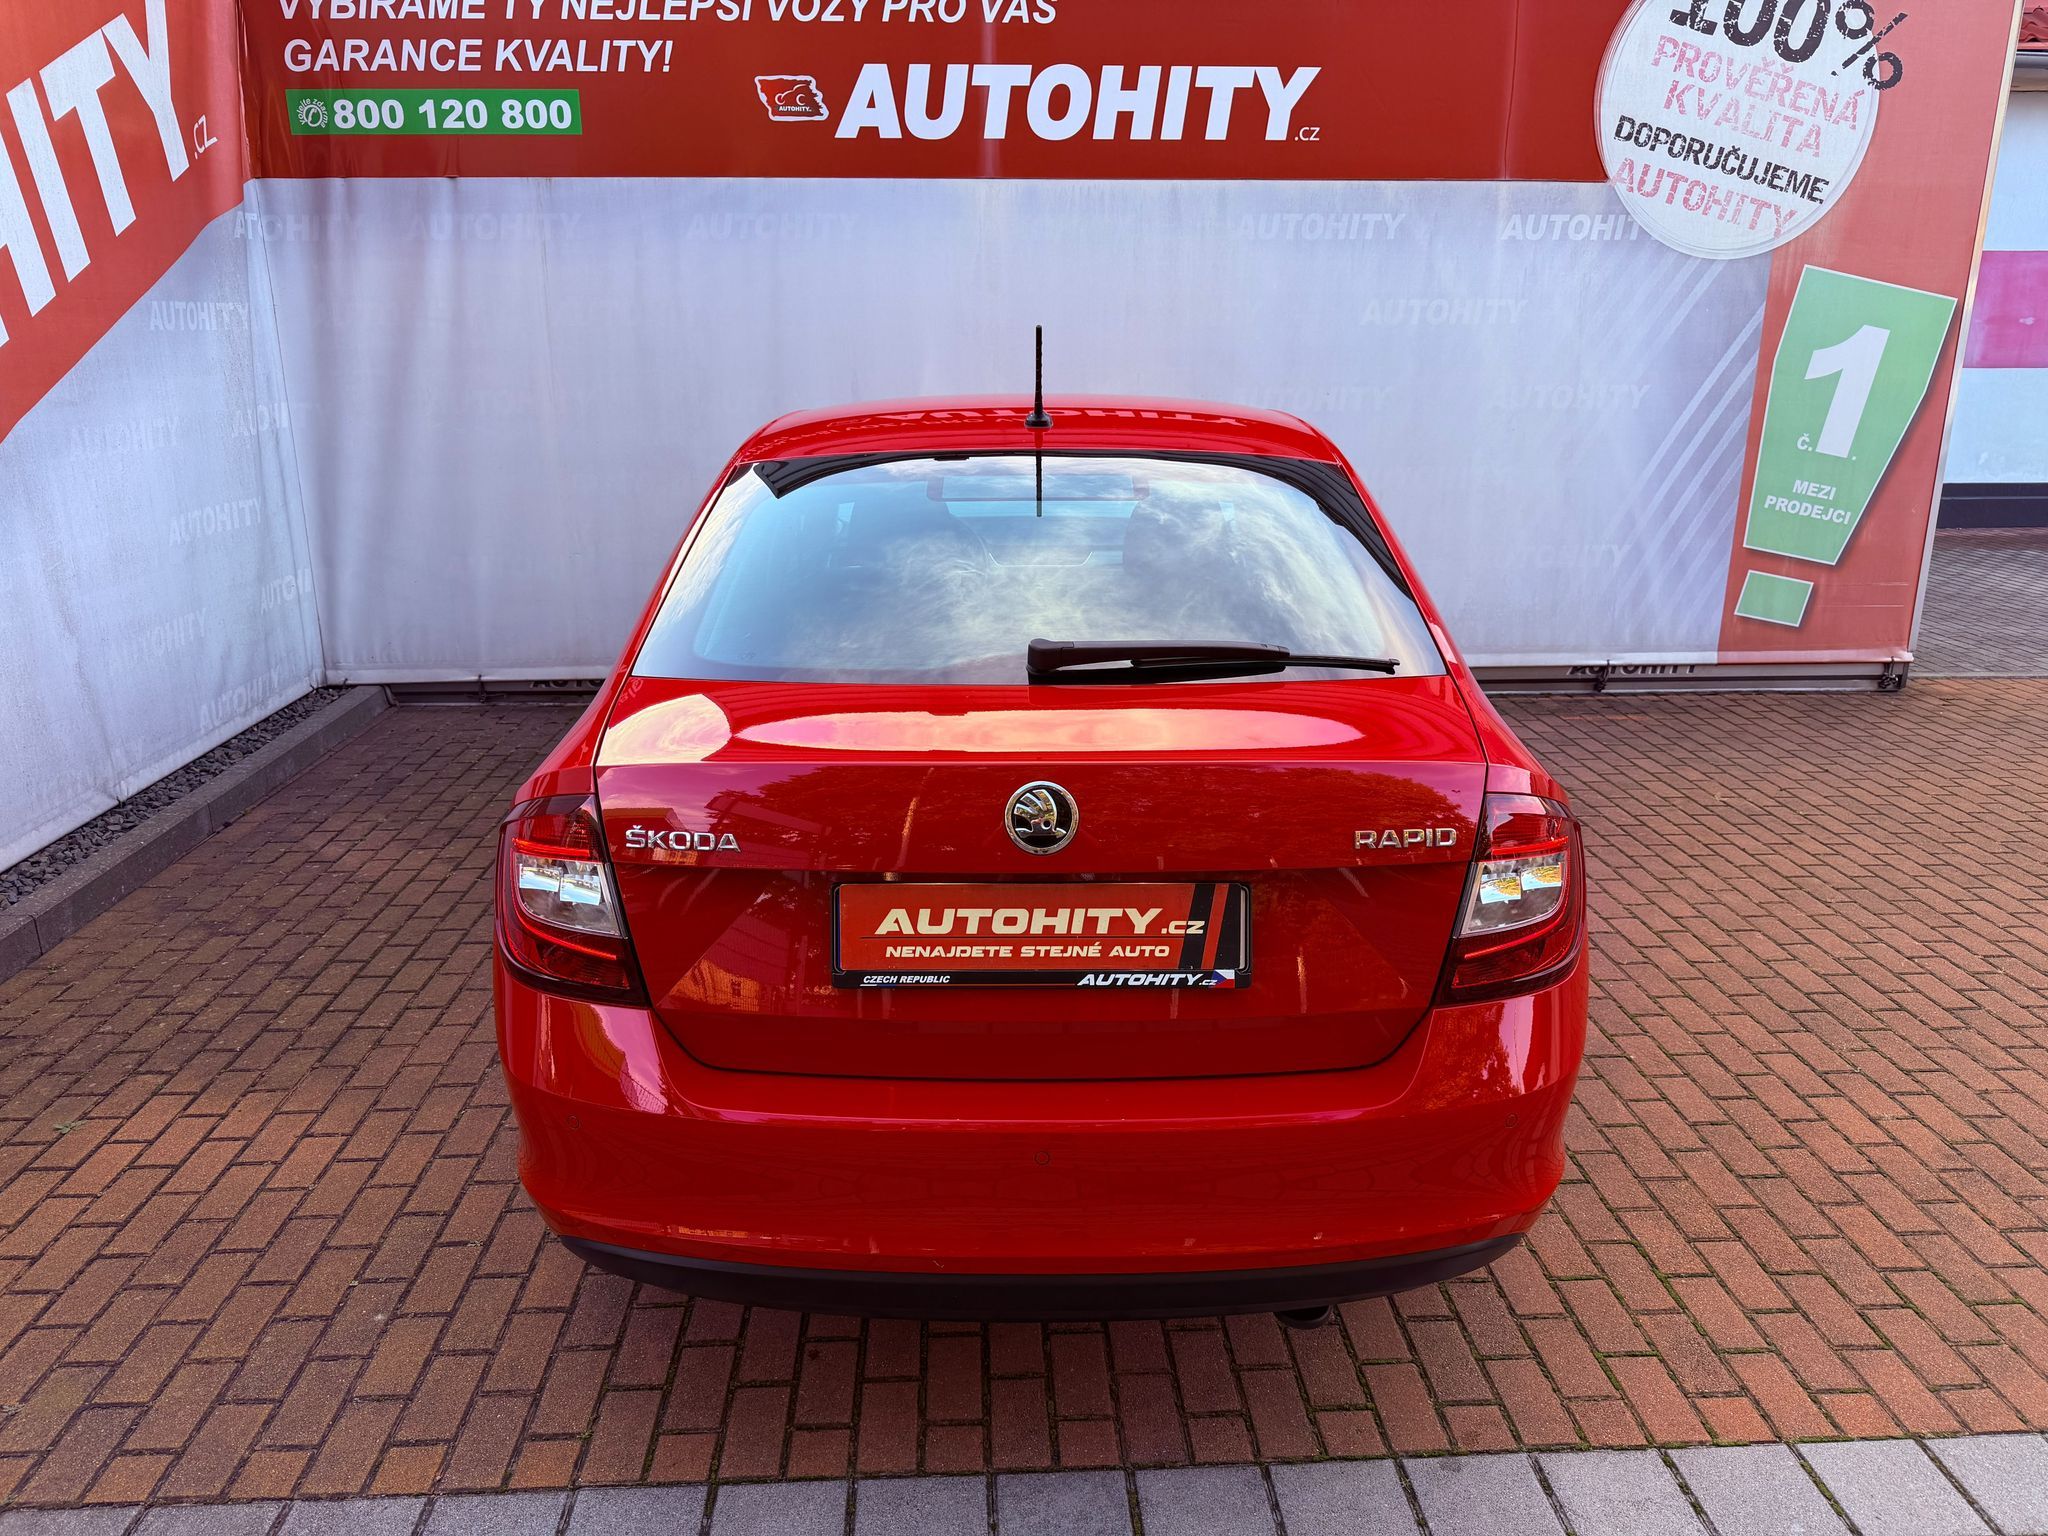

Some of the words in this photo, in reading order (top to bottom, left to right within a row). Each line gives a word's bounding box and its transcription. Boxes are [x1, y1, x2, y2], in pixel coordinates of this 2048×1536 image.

[882, 0, 964, 22] PRO
[284, 39, 483, 72] GARANCE
[494, 40, 673, 73] KVALITY!
[1650, 35, 1865, 131] PROVĚŘENÁ
[333, 98, 404, 130] 800
[418, 98, 488, 129] 120
[501, 98, 572, 130] 800
[1663, 80, 1822, 158] KVALITA
[1613, 114, 1830, 205] DOPORUČUJEME
[1607, 157, 1799, 239] AUTOHITY
[1235, 213, 1407, 241] AUTOHITY
[1500, 213, 1660, 242] AUTOHIT
[150, 301, 249, 331] AUTOHITY
[1359, 298, 1528, 326] AUTOHITY
[1792, 479, 1836, 501] MEZI
[1764, 495, 1852, 525] PRODEJCI
[625, 824, 741, 853] ŠKODA
[1354, 827, 1457, 849] RAPID
[885, 946, 1013, 958] NENAJDETE
[1020, 941, 1103, 958] STEJNÉ
[1108, 945, 1170, 957] AUTO
[863, 975, 898, 984] CZECH
[899, 975, 950, 984] REPUBLIC
